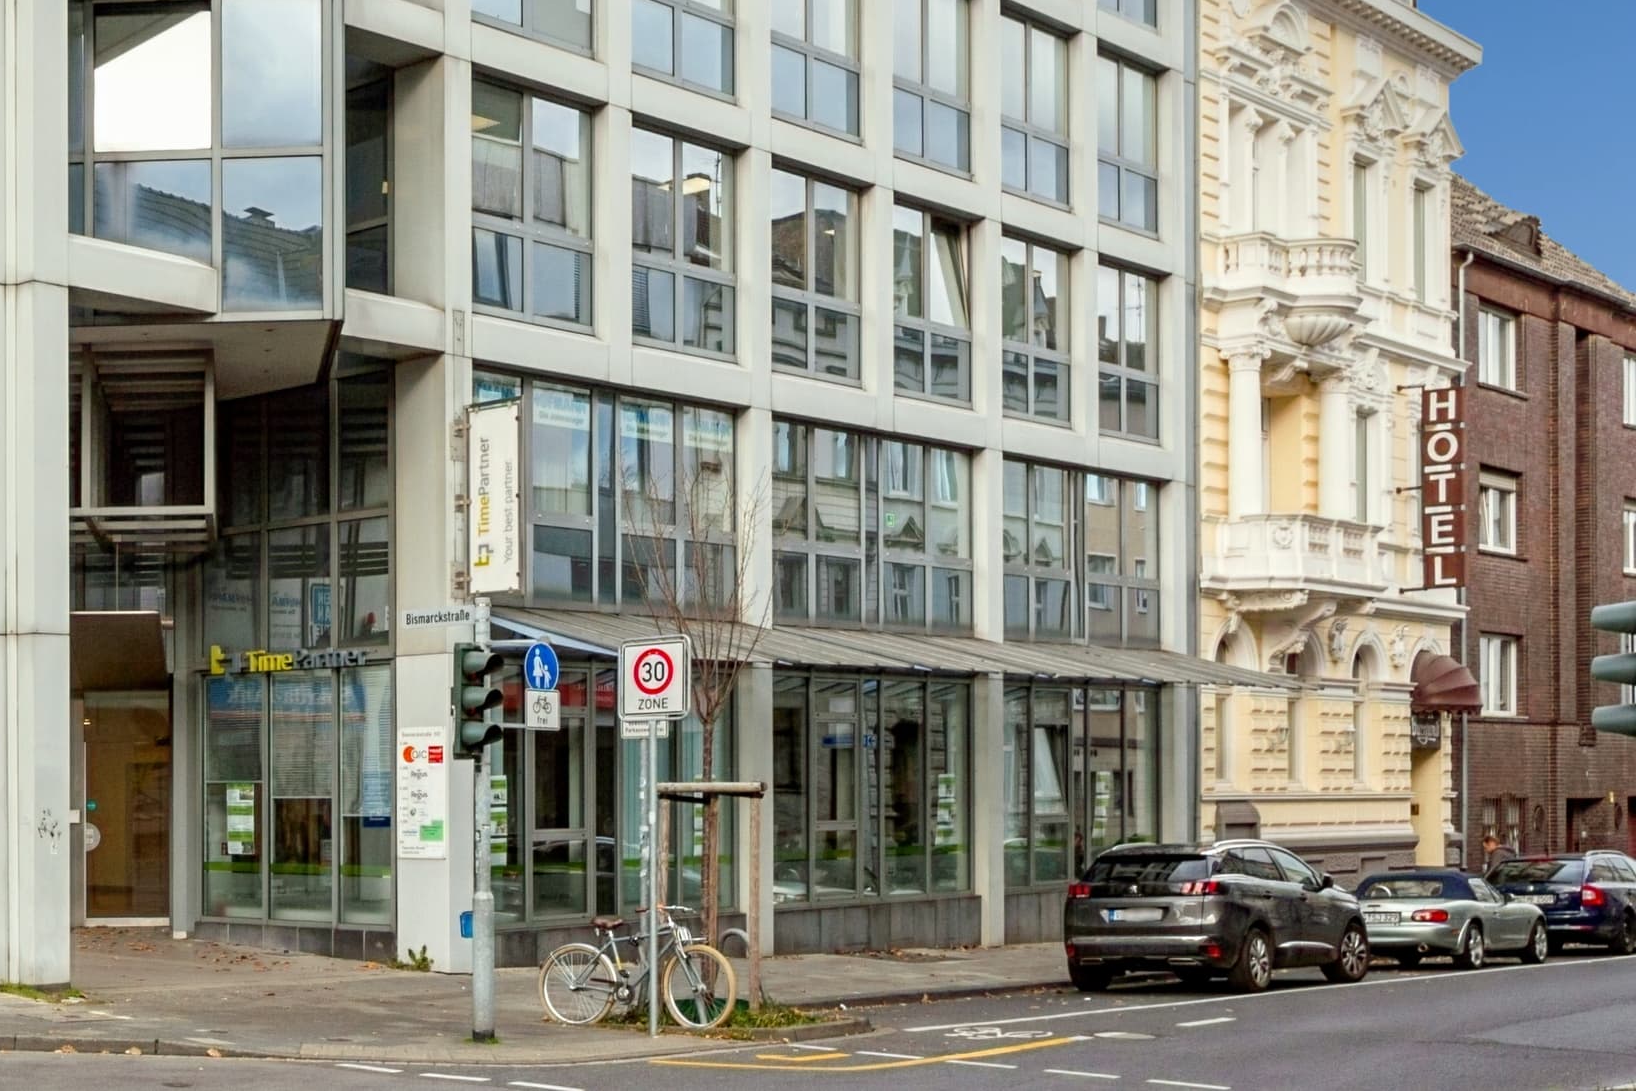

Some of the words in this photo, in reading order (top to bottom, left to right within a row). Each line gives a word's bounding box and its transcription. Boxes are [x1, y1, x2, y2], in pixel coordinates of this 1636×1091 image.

[478, 436, 490, 537] TimePartner
[1427, 389, 1459, 586] HOTEL
[405, 610, 470, 626] Bismarckstraße
[245, 647, 367, 673] TimePartner
[642, 661, 666, 683] 30
[638, 697, 668, 710] ZONE
[536, 716, 548, 725] frei
